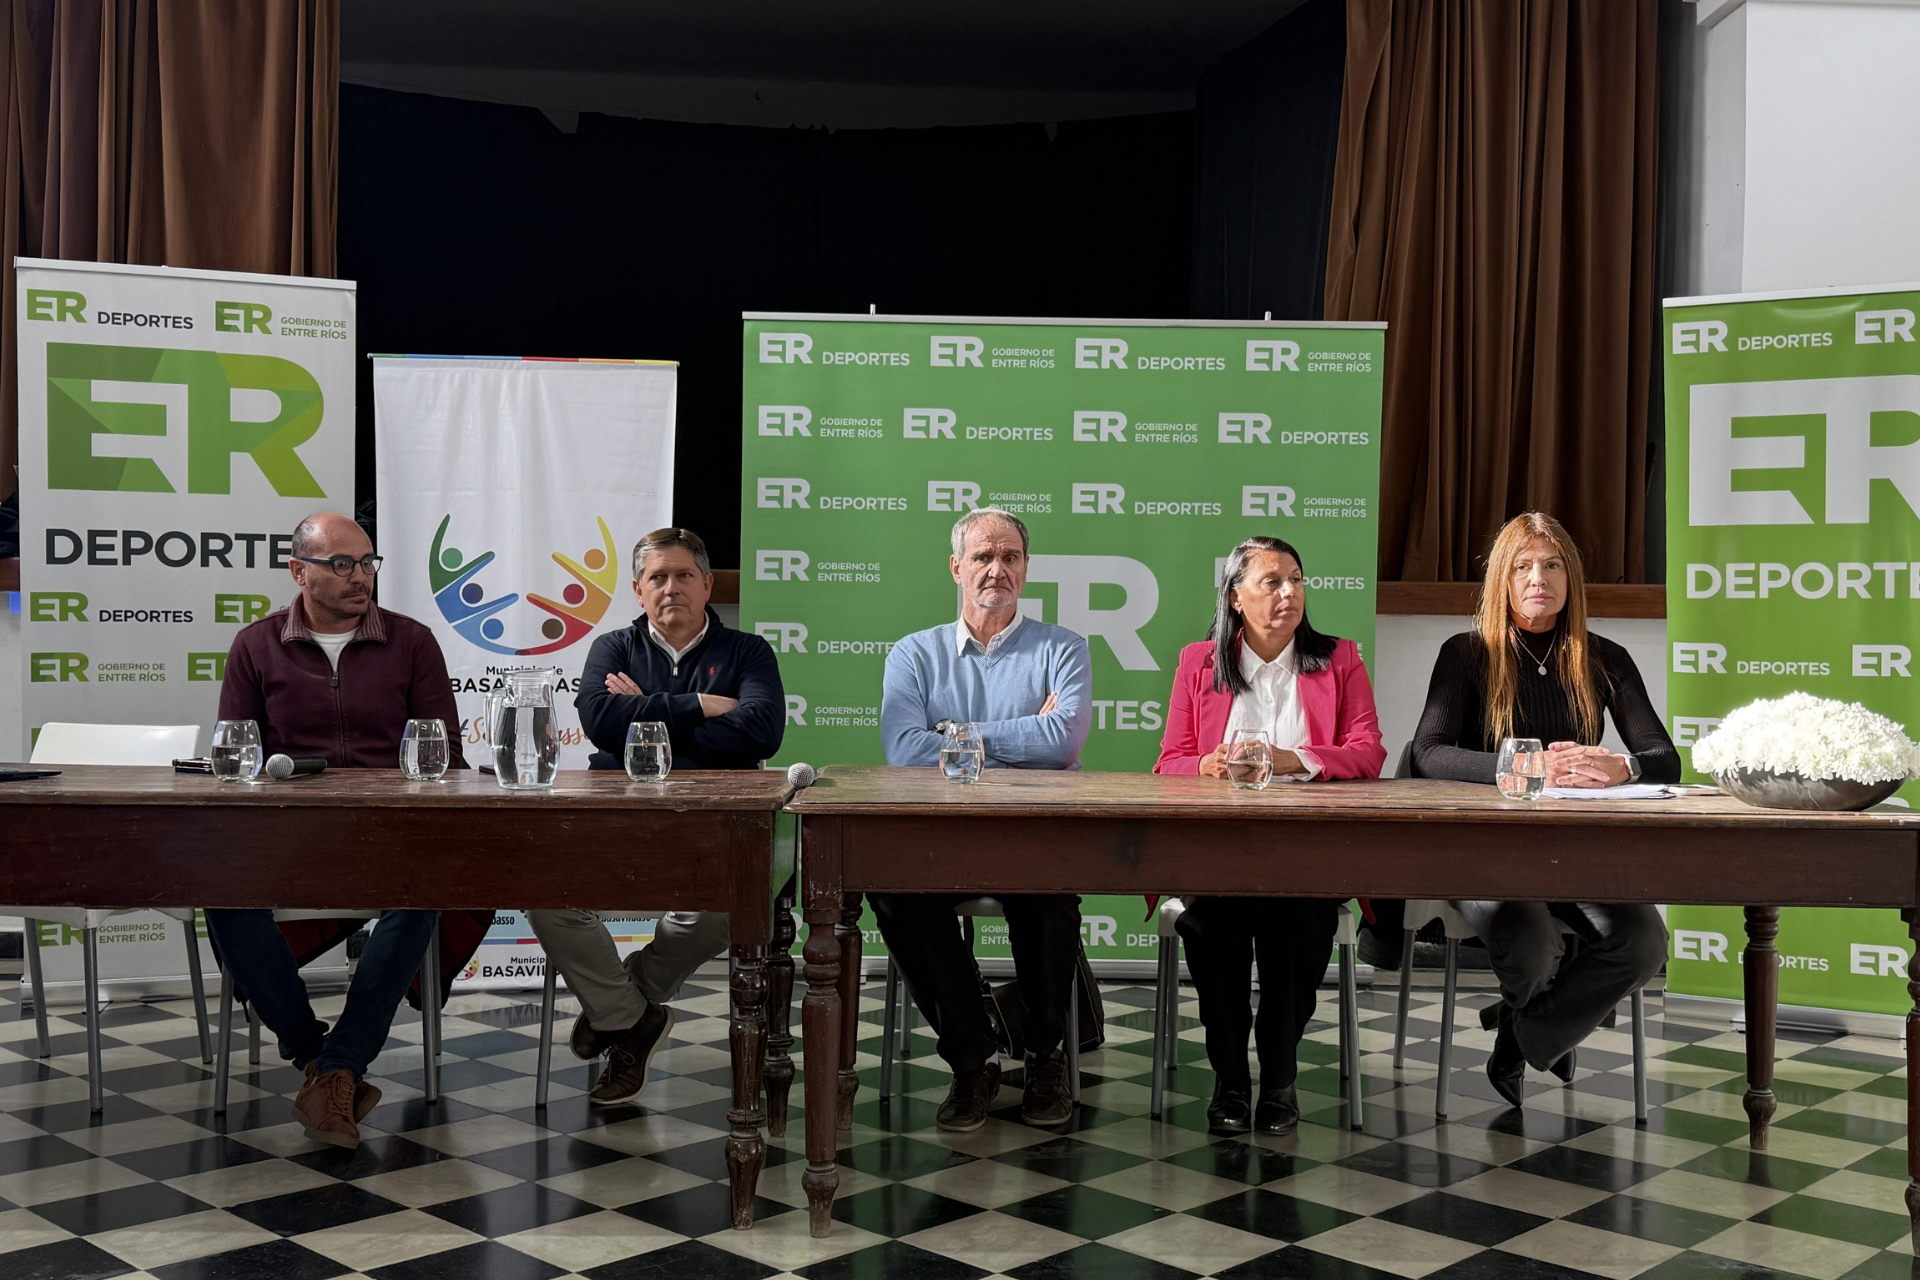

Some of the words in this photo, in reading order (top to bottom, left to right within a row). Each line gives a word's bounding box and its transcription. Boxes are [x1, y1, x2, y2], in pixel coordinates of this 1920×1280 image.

[27, 289, 86, 323] ER
[98, 312, 193, 329] DEPORTES
[216, 301, 272, 334] ER
[281, 317, 331, 327] GOBIERNO
[281, 328, 317, 337] ENTRE
[321, 328, 347, 339] RÍOS
[1673, 321, 1728, 354] ER
[1738, 333, 1832, 350] DEPORTES
[1855, 309, 1915, 344] ER
[760, 333, 812, 364] ER
[823, 352, 910, 365] DEPORTES
[930, 336, 984, 367] ER
[992, 348, 1040, 356] GOBIERNO
[992, 359, 1026, 367] ENTRE
[1031, 358, 1054, 368] RÍOS
[1075, 338, 1128, 369] ER
[1138, 357, 1225, 370] DEPORTES
[1246, 340, 1300, 371] ER
[1308, 352, 1356, 360] GOBIERNO
[1308, 363, 1343, 371] ENTRE
[1347, 362, 1371, 372] RÍOS
[47, 342, 327, 498] ER
[759, 405, 812, 436] ER
[820, 418, 868, 426] GOBIERNO
[820, 429, 855, 437] ENTRE
[859, 428, 883, 437] RÍOS
[904, 408, 956, 439] ER
[966, 427, 1053, 440] DEPORTES
[1074, 411, 1127, 441] ER
[1135, 423, 1183, 431] GOBIERNO
[1218, 413, 1271, 443] ER
[1281, 432, 1369, 444] DEPORTES
[1135, 434, 1169, 442] ENTRE
[1175, 433, 1197, 442] RÍOS
[757, 478, 810, 508] ER
[820, 497, 907, 510] DEPORTES
[928, 481, 981, 511] ER
[988, 493, 1036, 502] GOBIERNO
[1026, 503, 1052, 513] RÍOS
[1072, 483, 1125, 514] ER
[1135, 502, 1221, 515] DEPORTES
[1242, 486, 1295, 516] ER
[1304, 508, 1338, 517] ENTRE
[1343, 507, 1366, 517] RÍOS
[45, 528, 293, 569] DEPORTE
[756, 550, 809, 581] ER
[818, 573, 852, 581] ENTRE
[857, 572, 880, 582] RÍOS
[1304, 577, 1365, 590] PORTES
[30, 592, 88, 622] ER
[100, 610, 193, 622] DEPORTES
[215, 594, 271, 623] ER
[817, 641, 893, 654] DEPORTE
[1673, 642, 1726, 673] ER
[1737, 661, 1830, 675] DEPORTES
[1852, 645, 1911, 677] ER
[31, 653, 89, 682] ER
[99, 674, 135, 682] ENTRE
[141, 672, 165, 681] RÍOS
[784, 695, 808, 726] R
[815, 706, 862, 714] GOBIERNO
[815, 718, 850, 726] ENTRE
[853, 716, 878, 726] RÍOS
[99, 924, 149, 932] GOBIERNO
[100, 934, 135, 943] ENTRE
[139, 932, 165, 941] RÍOS
[981, 936, 1010, 945] ENTR
[1674, 929, 1728, 962] ER
[511, 957, 545, 965] Municip
[1850, 943, 1908, 978] ER
